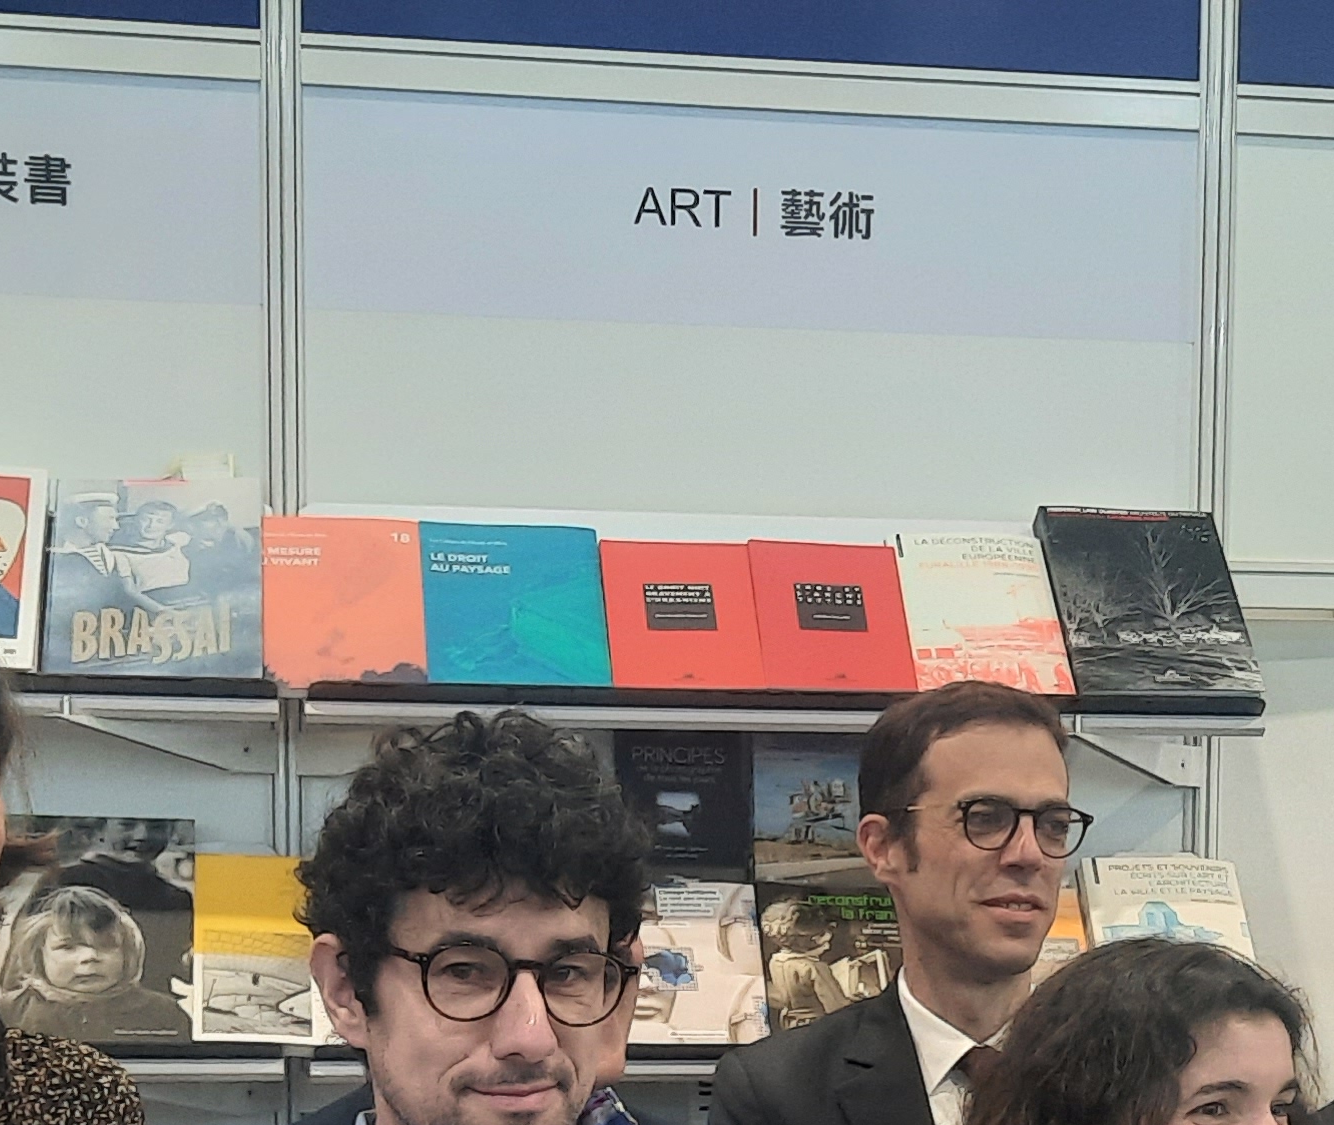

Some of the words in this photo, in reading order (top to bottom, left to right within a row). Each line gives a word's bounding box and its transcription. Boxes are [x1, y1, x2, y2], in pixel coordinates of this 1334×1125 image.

[634, 187, 732, 227] ART
[780, 189, 875, 239] 藝術
[390, 532, 411, 543] 18
[447, 554, 488, 563] DROIT
[452, 565, 511, 574] PAYSAGE
